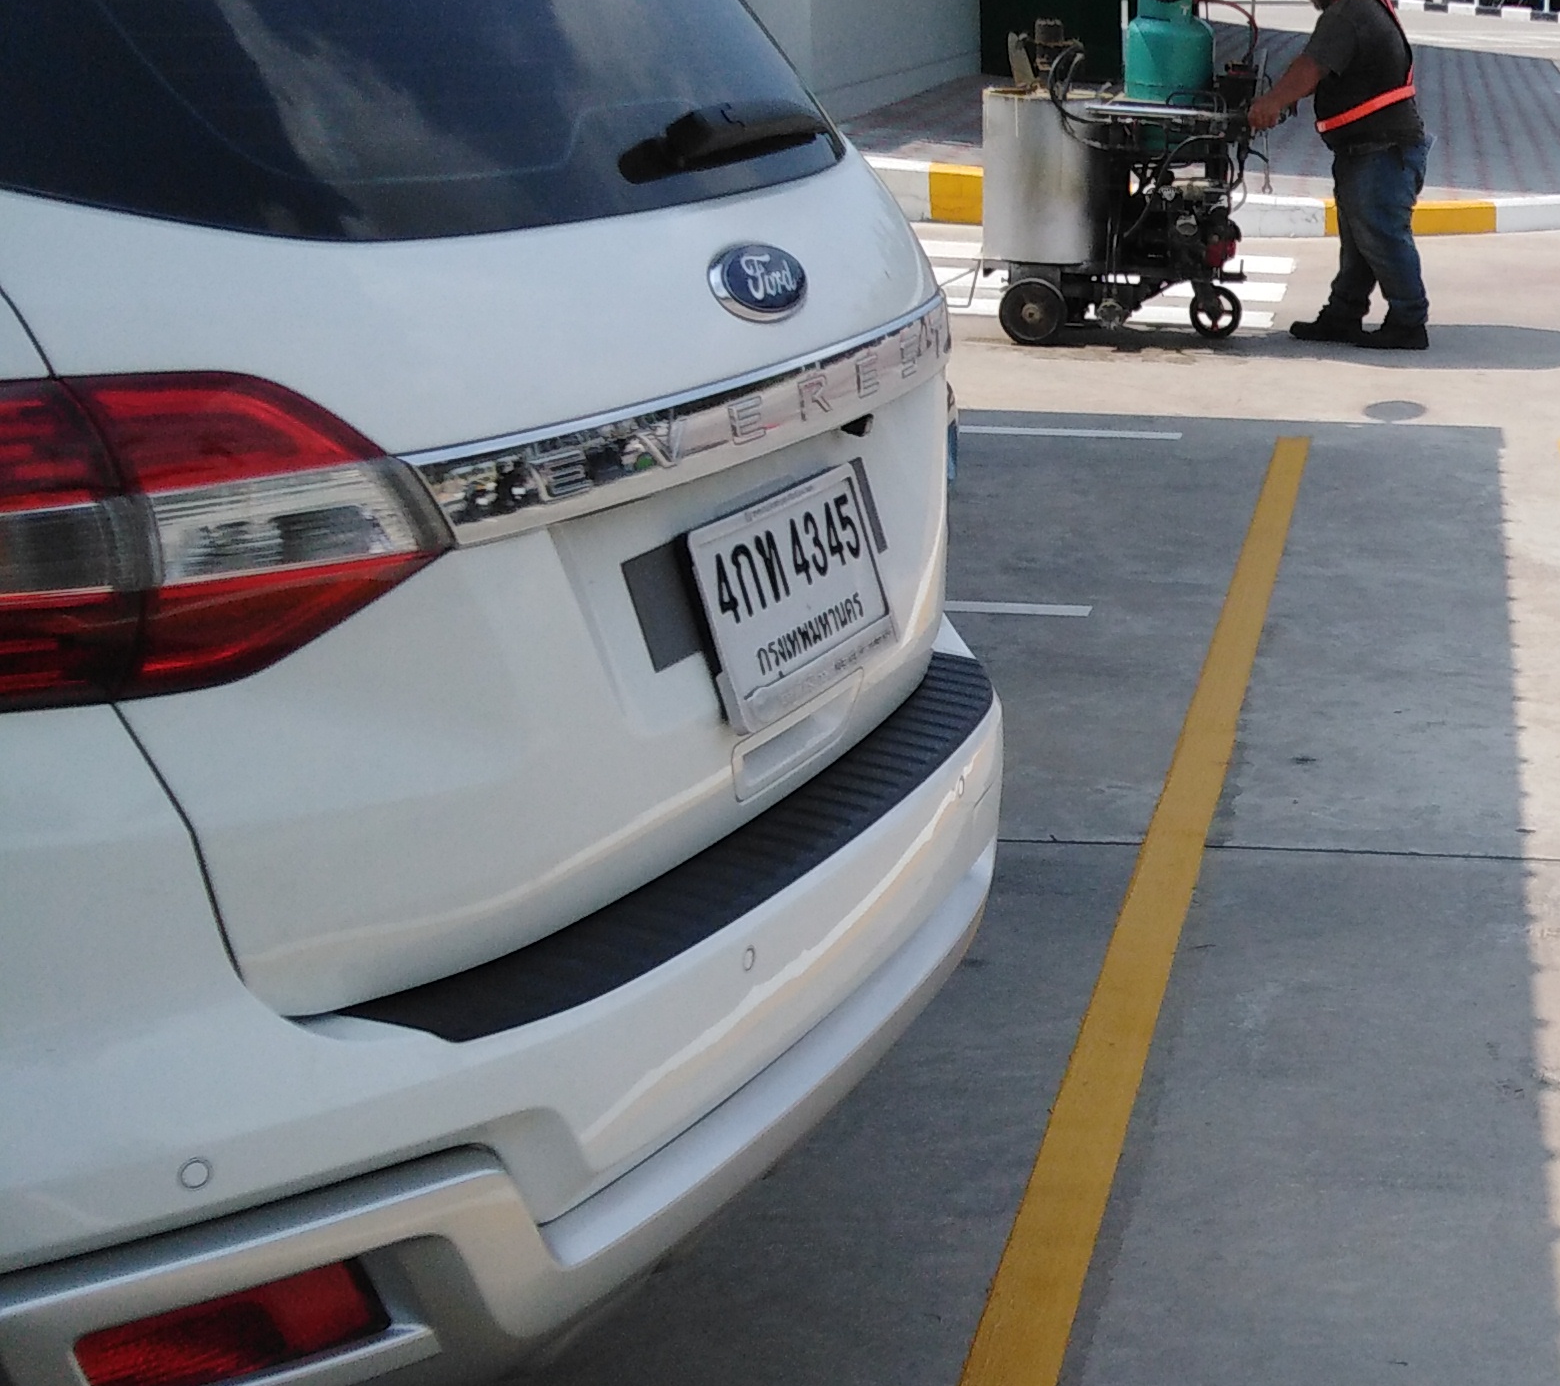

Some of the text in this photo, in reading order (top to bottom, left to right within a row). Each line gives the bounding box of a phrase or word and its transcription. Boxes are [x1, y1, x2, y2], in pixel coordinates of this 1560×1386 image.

[740, 253, 798, 301] Ford
[530, 310, 946, 503] EVEREST
[714, 529, 791, 625] 4กท
[788, 493, 861, 585] 4345
[756, 592, 865, 677] กรุงเทพมหานคร
